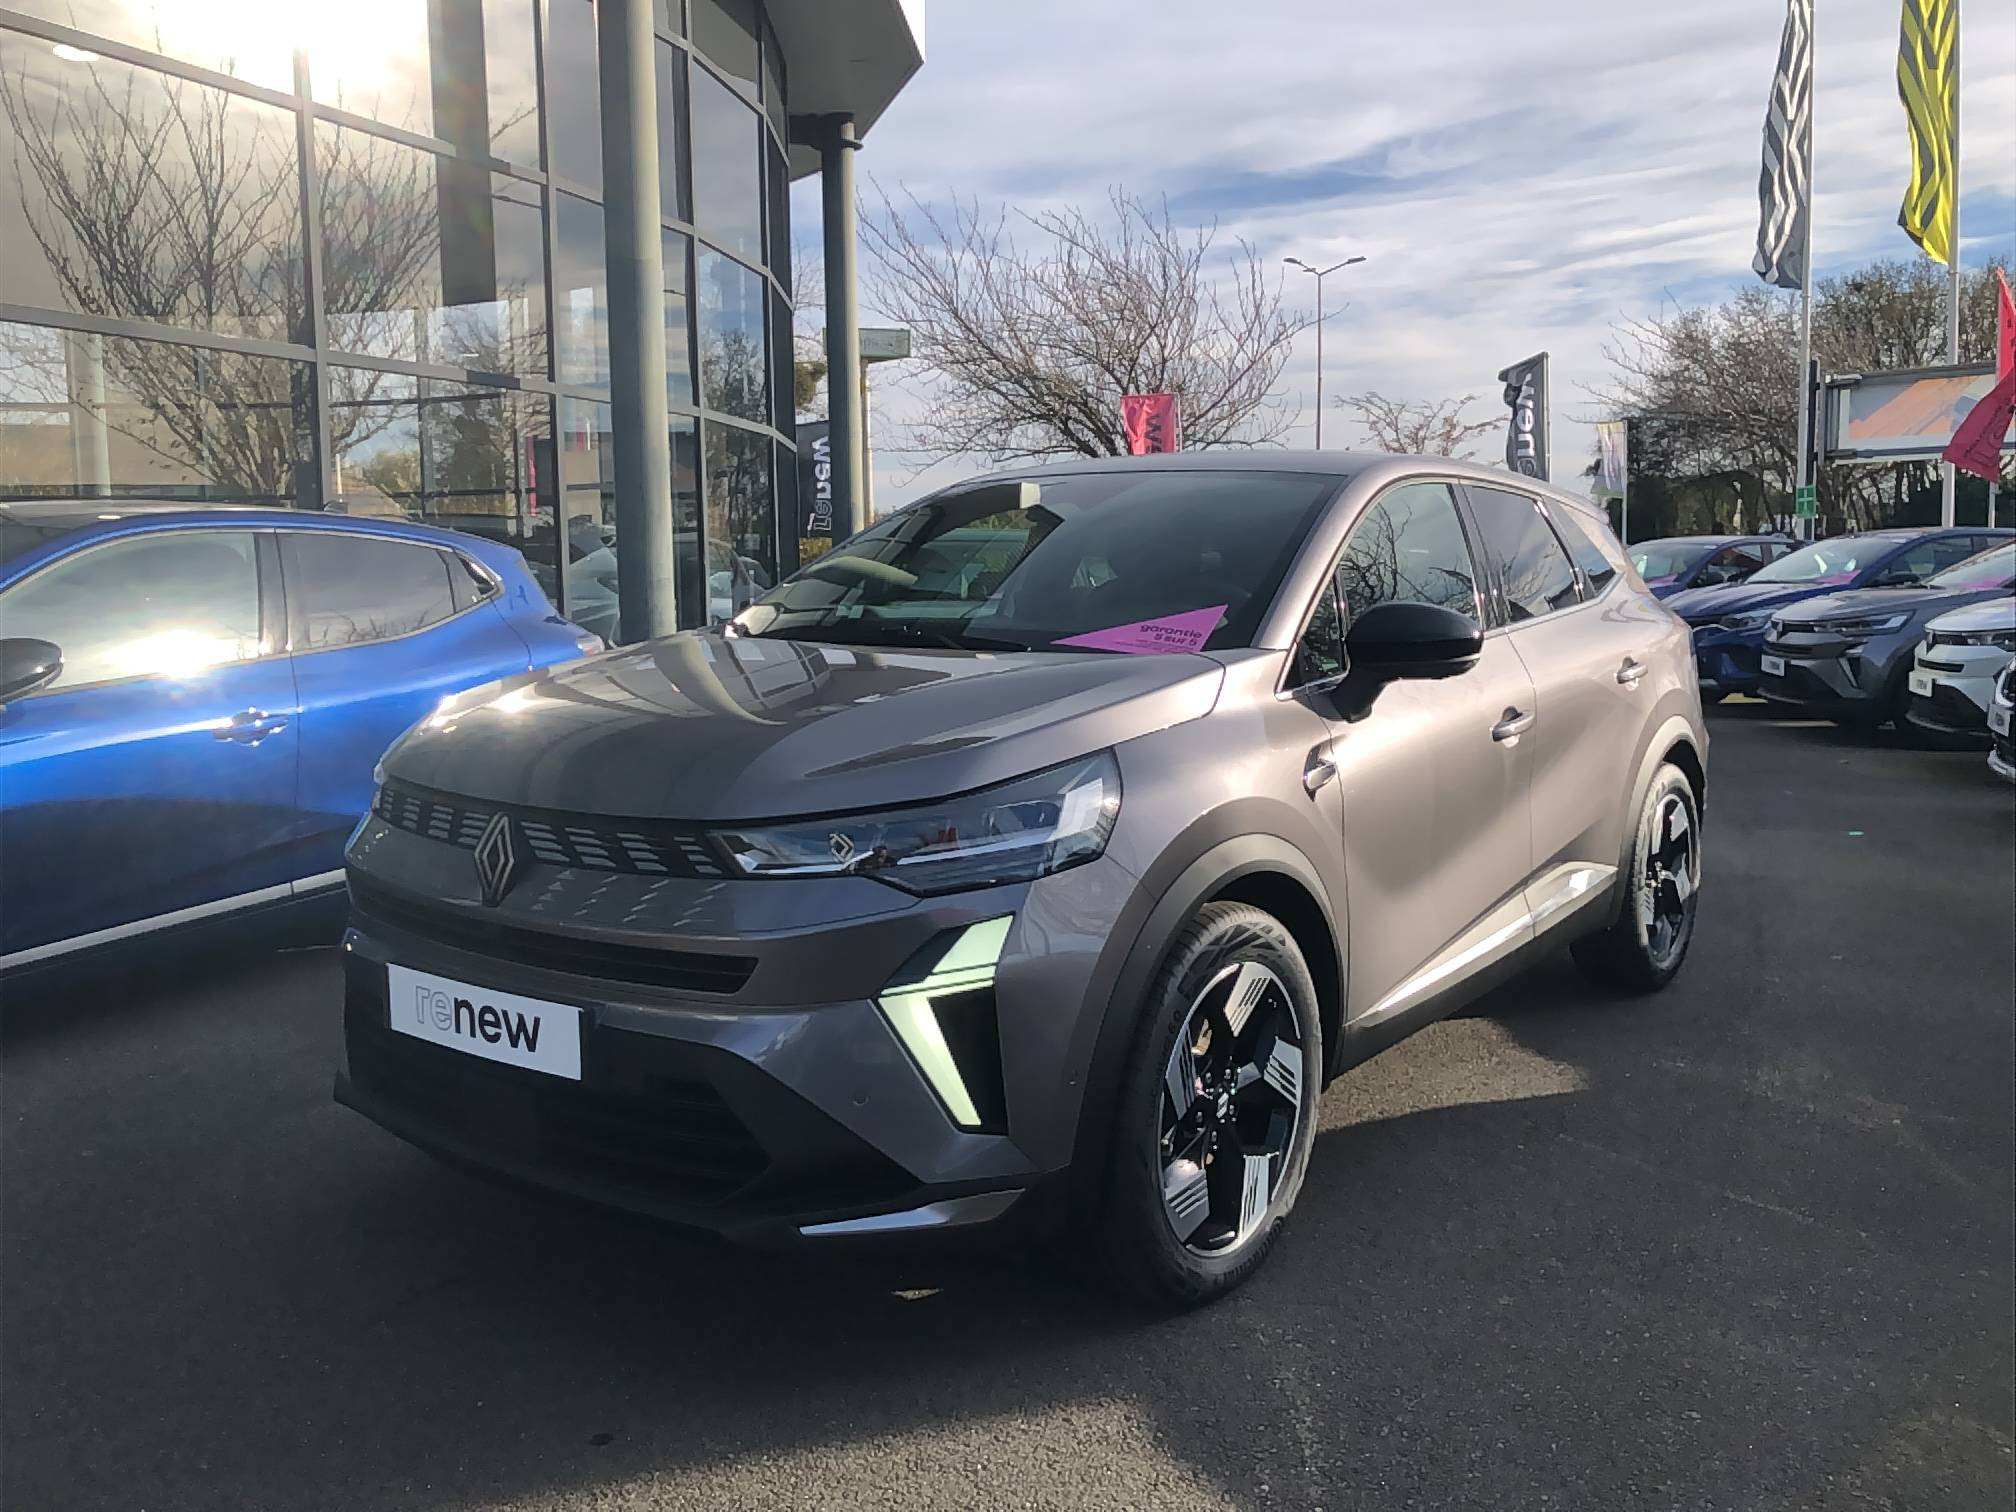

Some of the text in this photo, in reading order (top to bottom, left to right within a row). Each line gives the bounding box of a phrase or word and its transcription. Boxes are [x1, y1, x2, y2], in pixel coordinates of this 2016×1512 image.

[1140, 624, 1202, 638] garantie
[1164, 636, 1187, 644] sur
[415, 986, 541, 1053] renew
